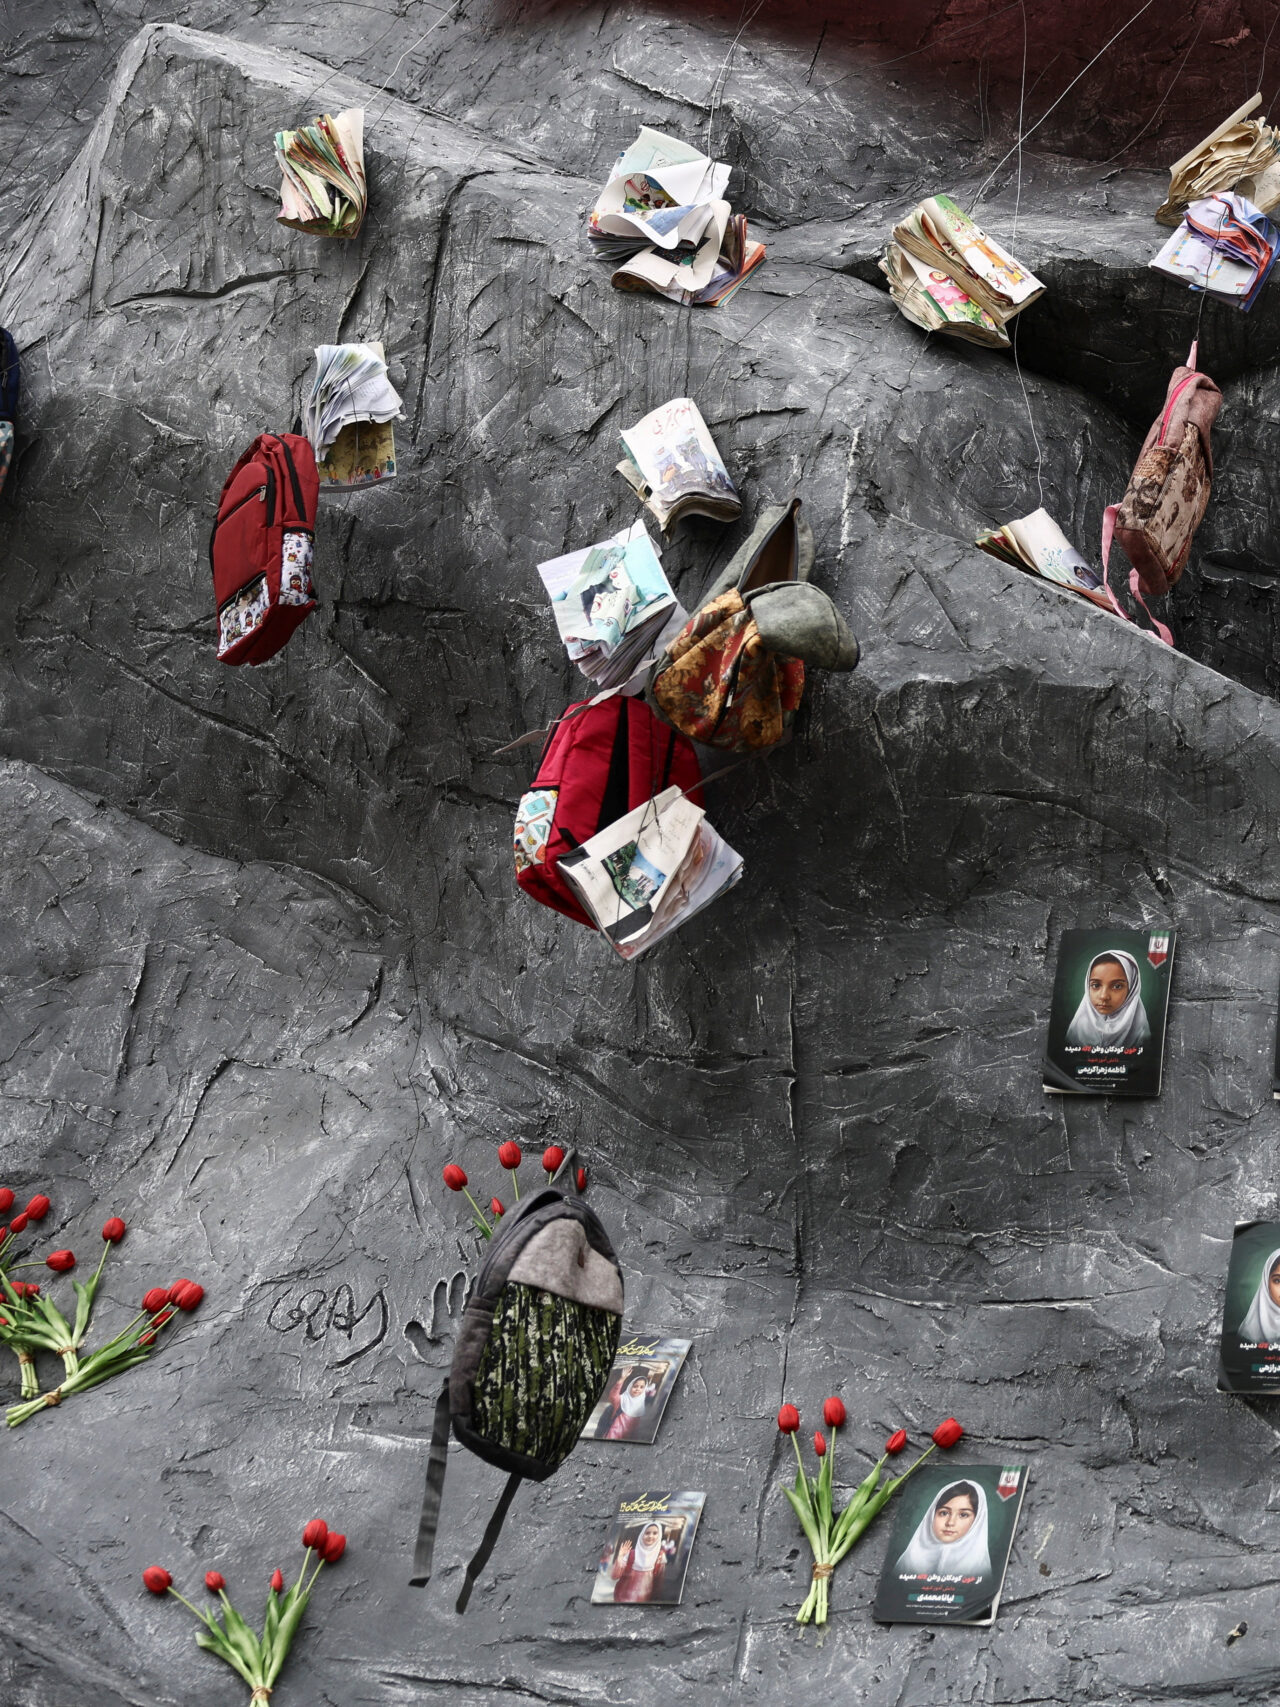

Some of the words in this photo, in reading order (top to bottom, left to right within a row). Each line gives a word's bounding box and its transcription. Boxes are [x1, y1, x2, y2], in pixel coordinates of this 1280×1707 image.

[1065, 1046, 1081, 1054] دمیده
[1091, 1045, 1104, 1054] وطن
[1104, 1046, 1124, 1054] کودکان
[1077, 1066, 1097, 1074] کریمی
[1108, 1065, 1126, 1074] فاطمه
[1240, 1342, 1257, 1351] دمیده
[927, 1574, 941, 1582] وطن
[941, 1574, 963, 1583] کودکان
[917, 1593, 941, 1602] محمدی
